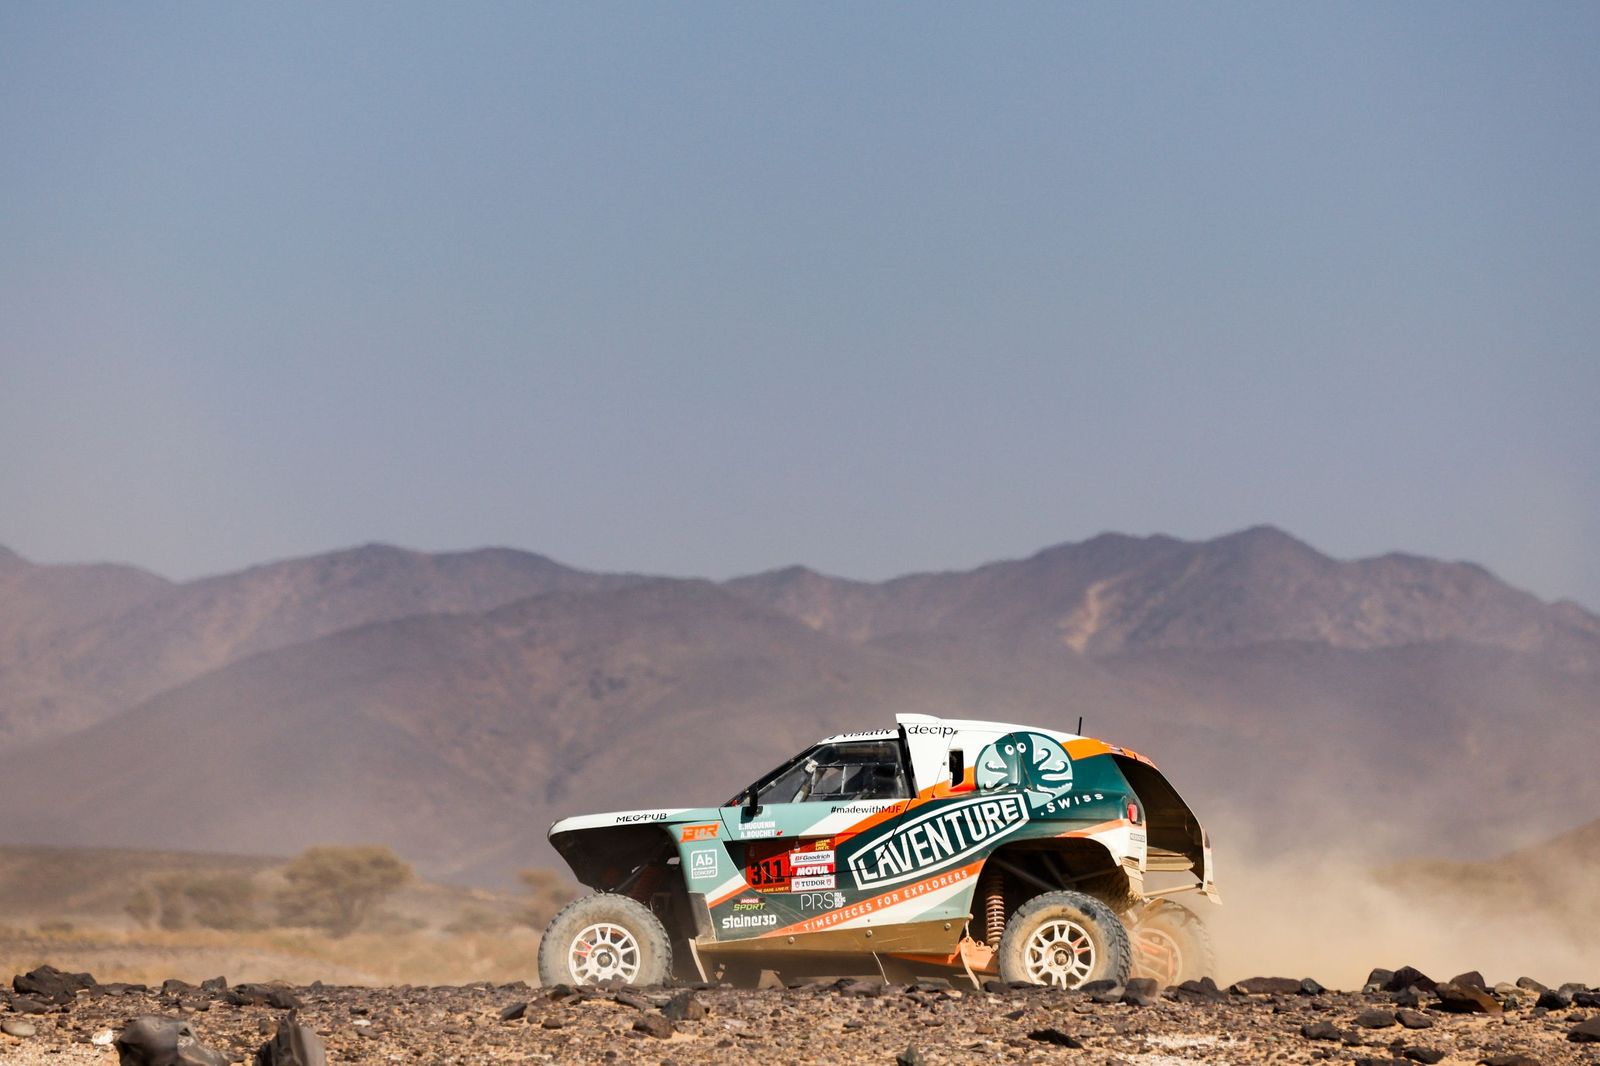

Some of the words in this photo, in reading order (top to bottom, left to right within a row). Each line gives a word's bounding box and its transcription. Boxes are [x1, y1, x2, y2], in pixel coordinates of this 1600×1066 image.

[830, 805, 901, 814] #madewithMJF
[858, 798, 1020, 881] LAVENTURE
[695, 853, 713, 867] Ab
[795, 854, 831, 862] BFGoodrich
[750, 859, 785, 885] 311
[796, 865, 829, 876] MOTUL
[733, 903, 766, 911] SPORT
[801, 892, 834, 911] PRS
[804, 904, 873, 931] TIMEPIECES
[877, 893, 899, 907] FOR
[904, 869, 969, 898] EXPLORERS
